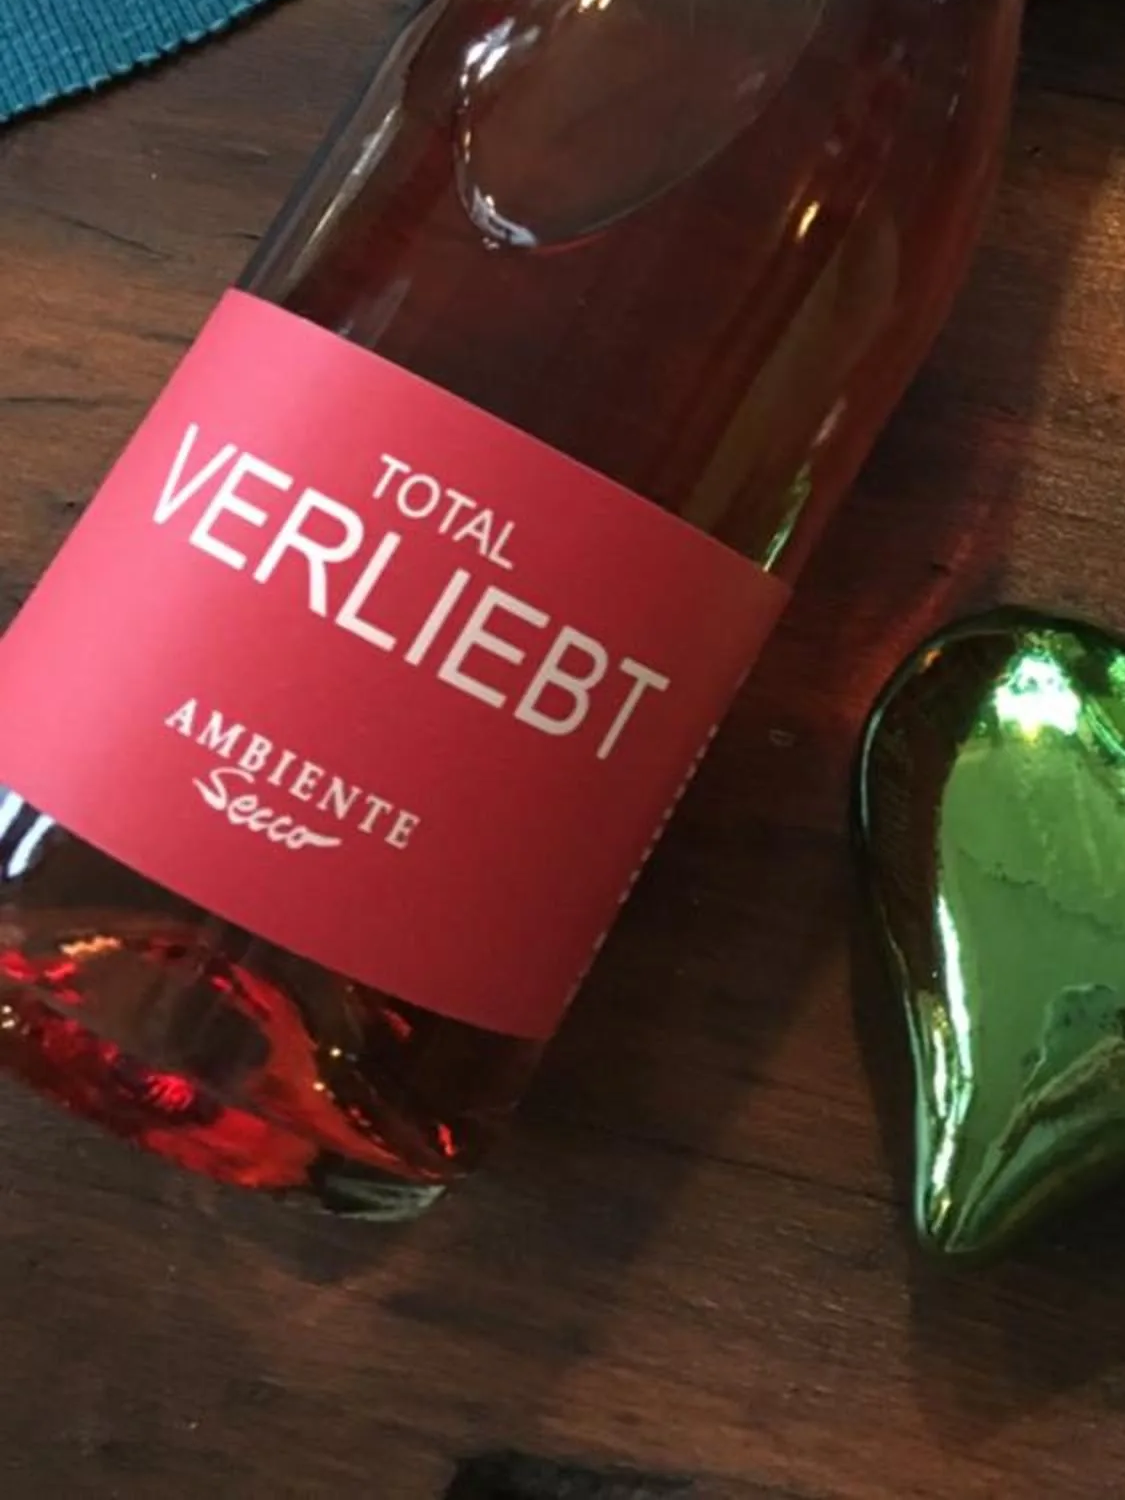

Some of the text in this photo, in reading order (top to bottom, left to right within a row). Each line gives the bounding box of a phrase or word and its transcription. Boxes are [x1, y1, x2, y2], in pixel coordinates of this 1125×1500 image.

[371, 453, 519, 571] TOTAL
[152, 424, 672, 761] VERLIEBT
[164, 698, 422, 850] AMBIENTE
[193, 766, 342, 851] Secco
